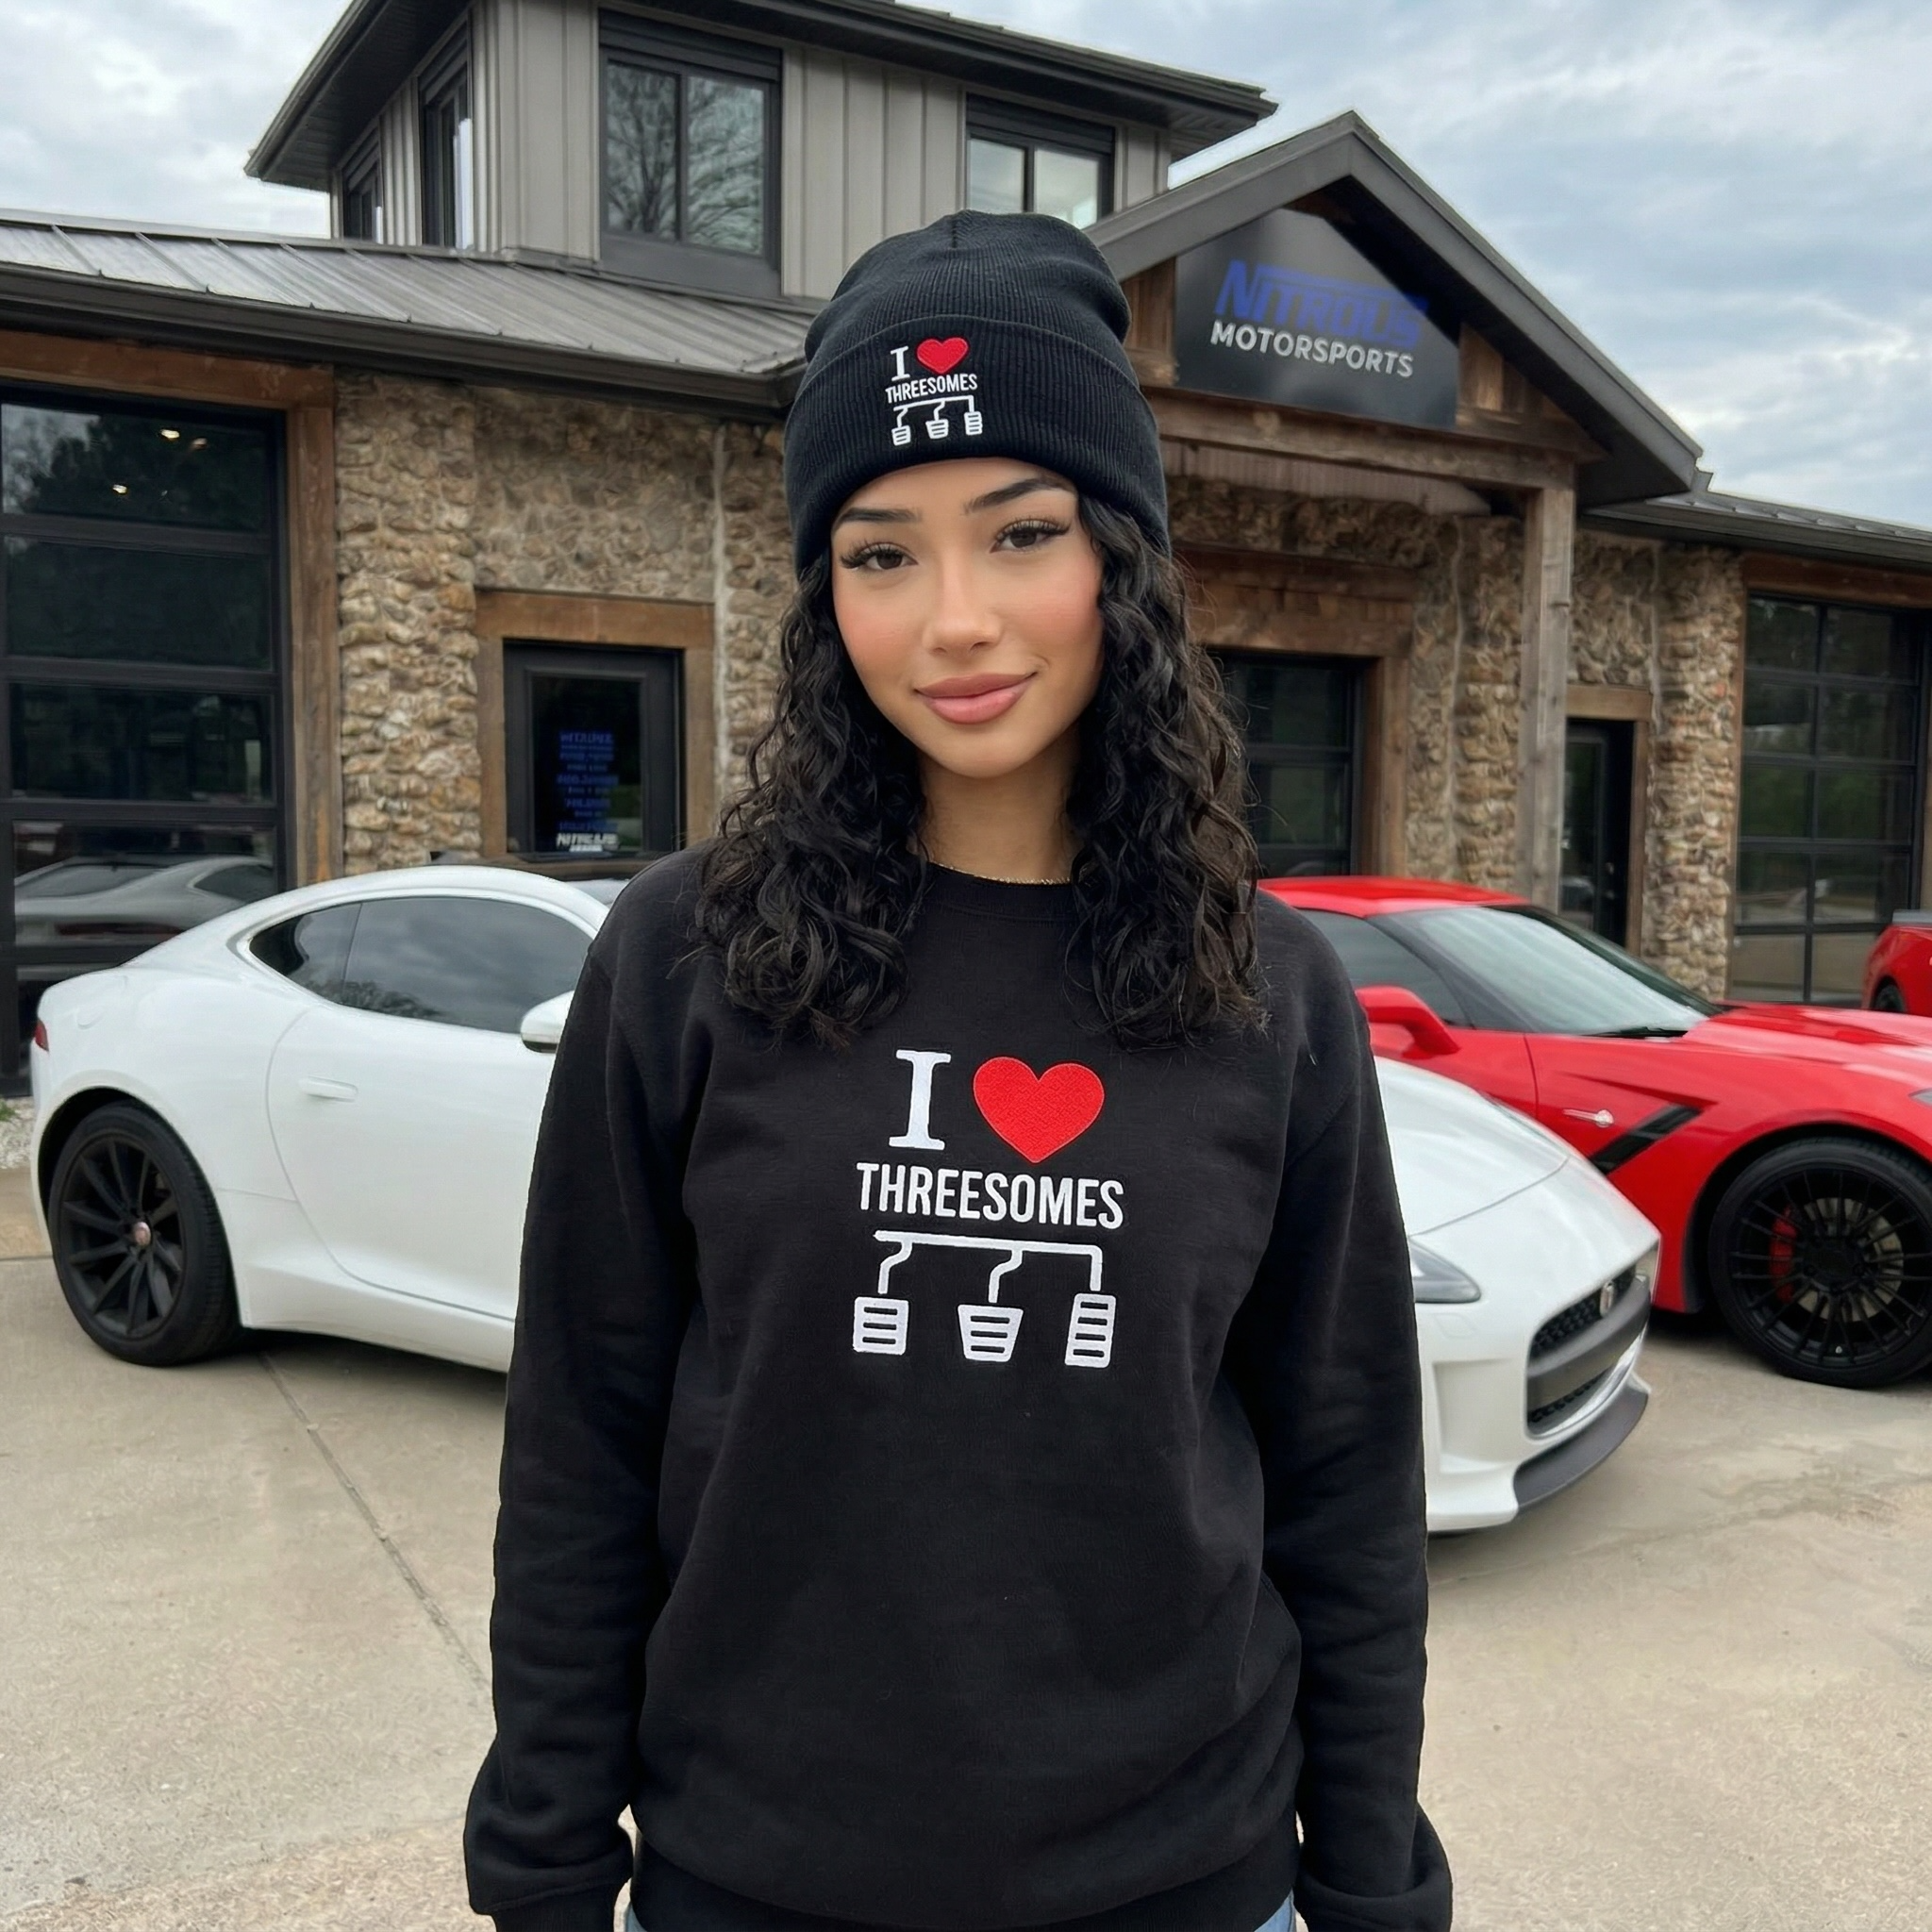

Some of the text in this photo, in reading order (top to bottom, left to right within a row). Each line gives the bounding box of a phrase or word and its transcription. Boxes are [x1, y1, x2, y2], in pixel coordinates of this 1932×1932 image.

[1213, 258, 1429, 351] NITROUS
[890, 345, 910, 382] I
[1209, 319, 1414, 377] MOTORSPORTS
[885, 373, 978, 404] THREESOMES
[889, 1049, 952, 1150] I
[856, 1162, 1124, 1230] THREESOMES
